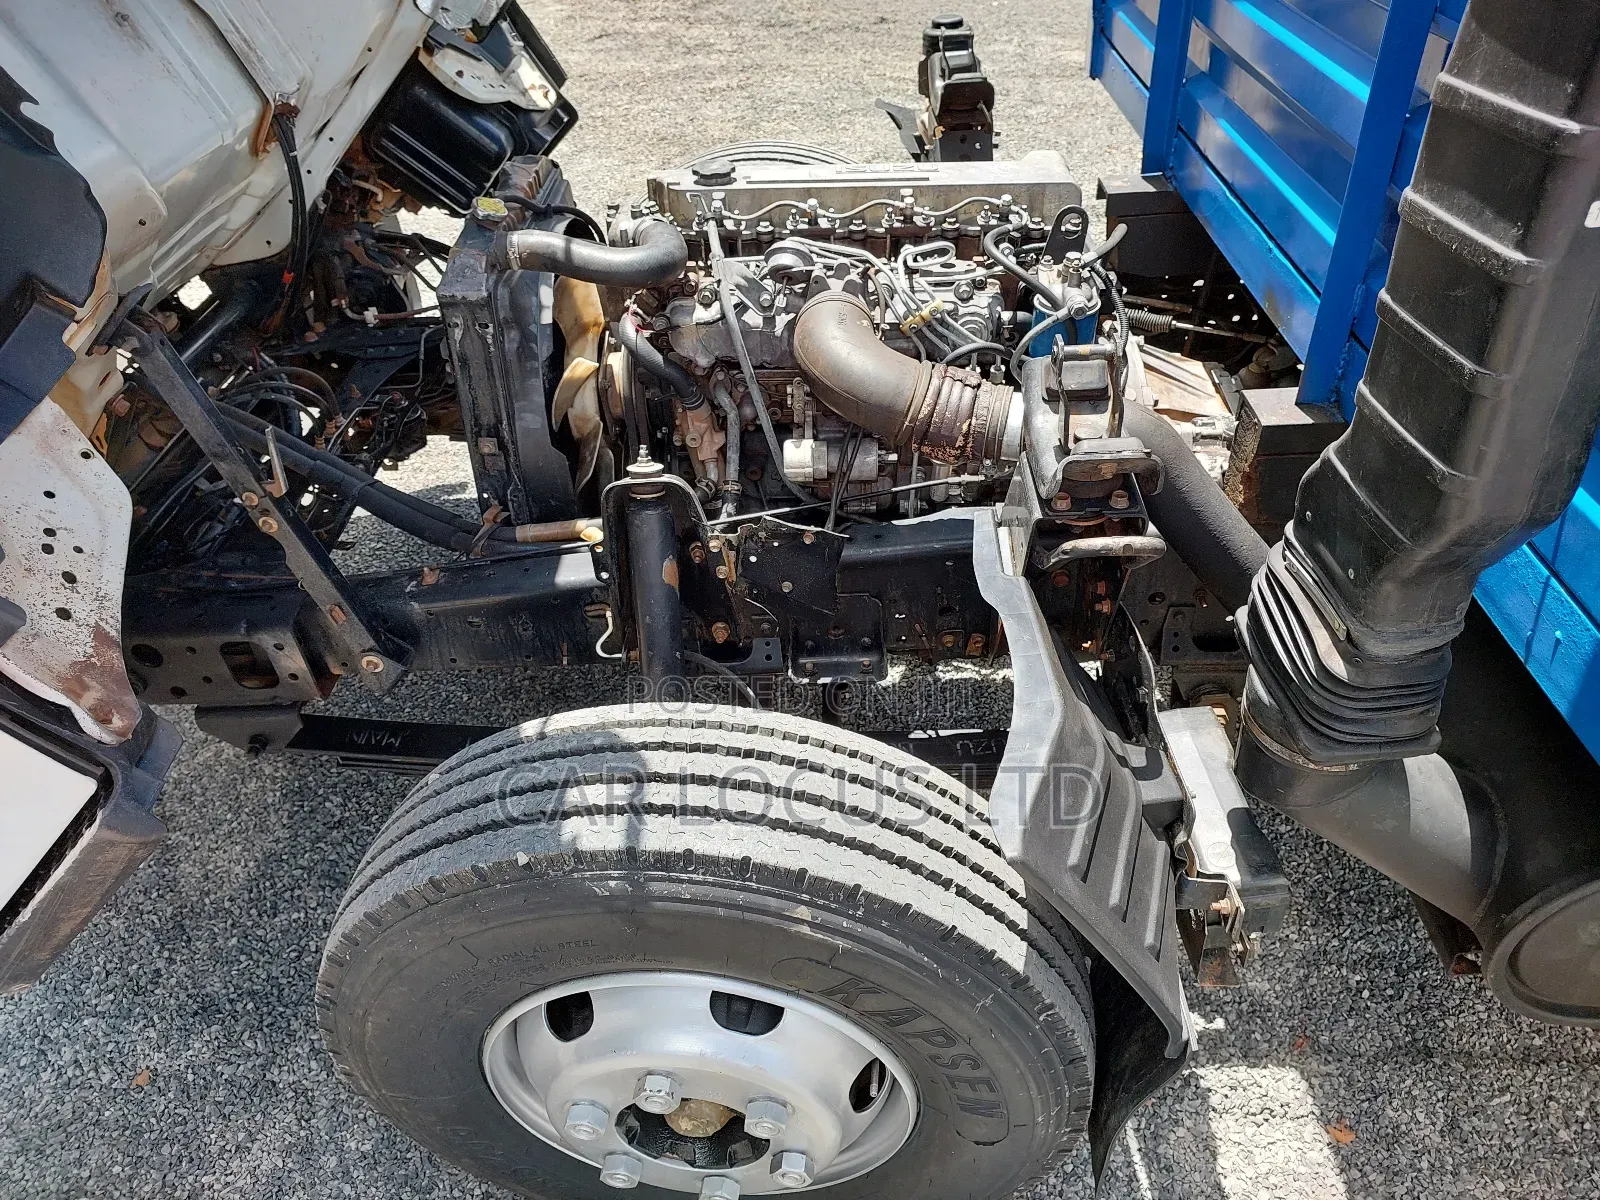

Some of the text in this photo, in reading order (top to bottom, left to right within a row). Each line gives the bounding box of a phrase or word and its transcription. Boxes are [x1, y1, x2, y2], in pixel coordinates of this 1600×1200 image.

[488, 949, 527, 966] RADIAL
[532, 944, 553, 955] ALL
[557, 938, 600, 951] STEEL
[816, 977, 1006, 1120] KAPSEN
